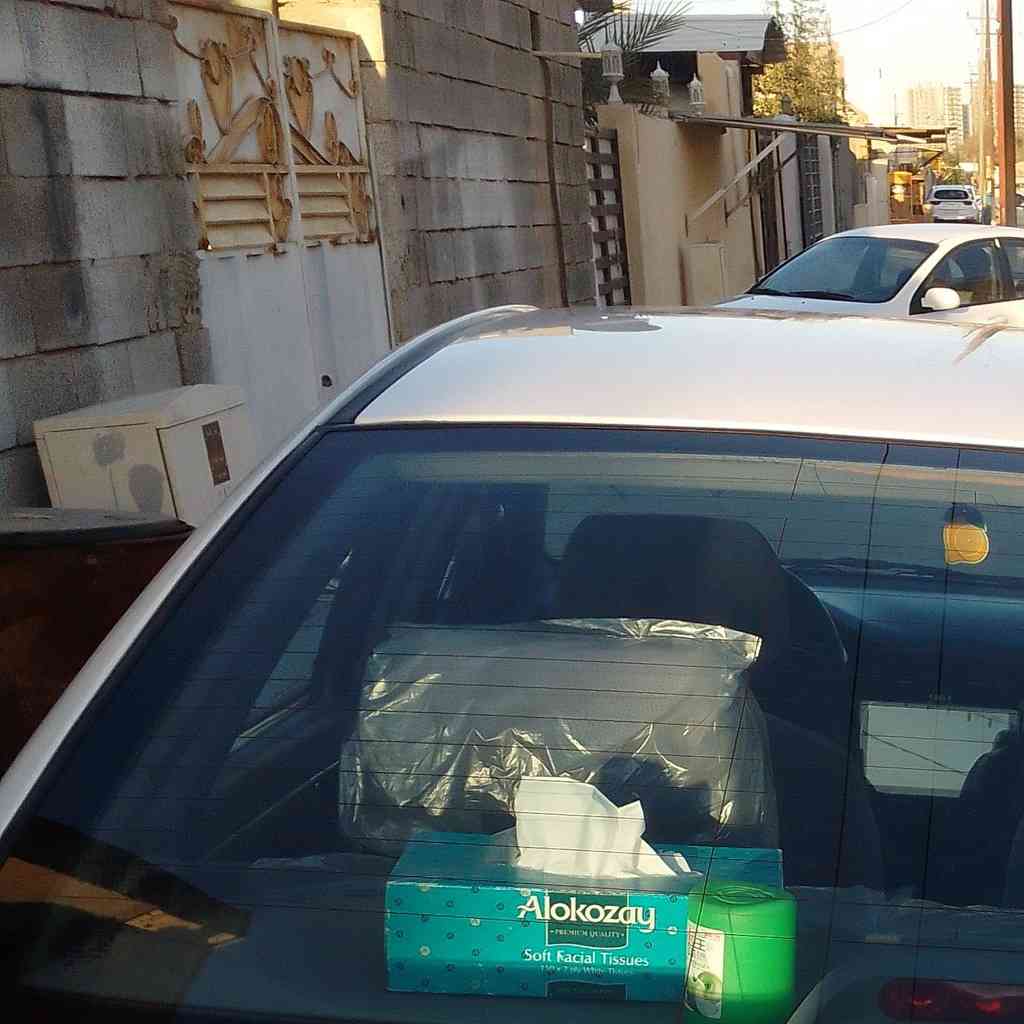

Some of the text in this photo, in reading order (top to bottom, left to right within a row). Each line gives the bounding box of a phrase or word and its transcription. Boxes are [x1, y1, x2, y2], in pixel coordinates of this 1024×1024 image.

[516, 895, 656, 933] Alokozay
[555, 928, 620, 939] PREMIUM QUALITY
[523, 948, 649, 967] Soft Facial Tissues
